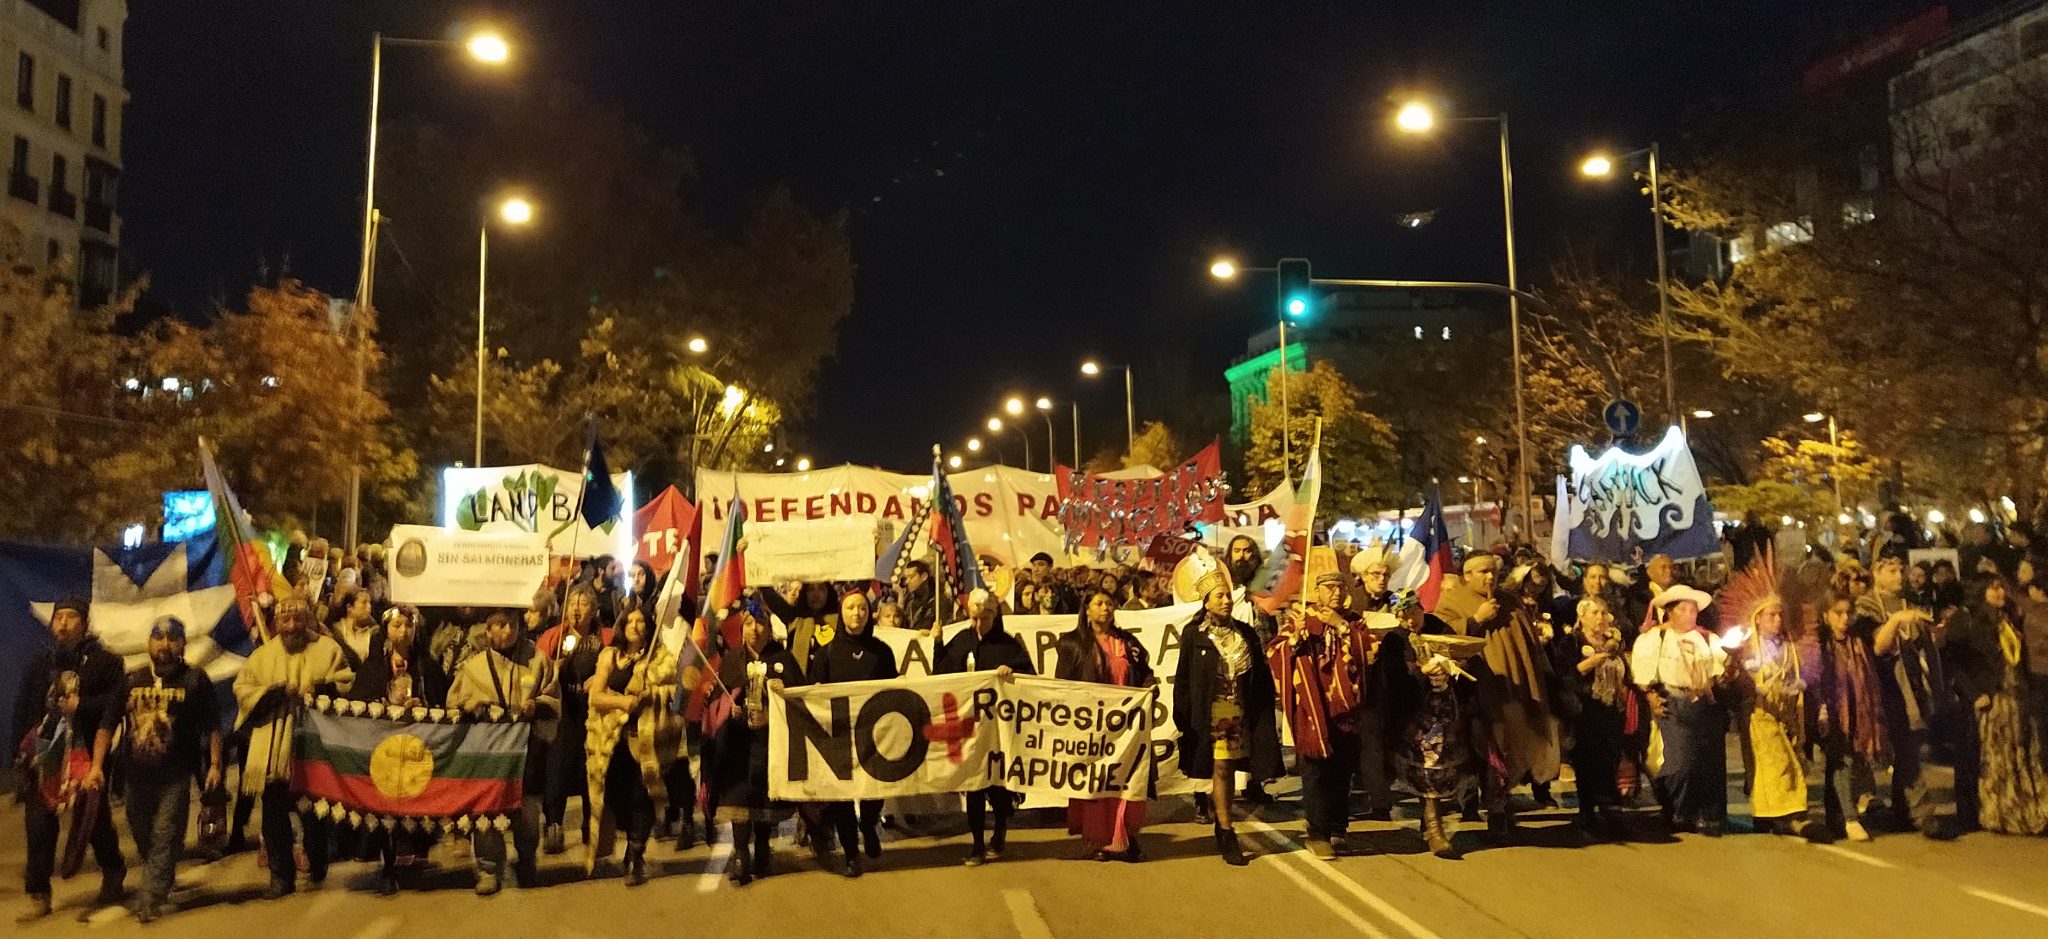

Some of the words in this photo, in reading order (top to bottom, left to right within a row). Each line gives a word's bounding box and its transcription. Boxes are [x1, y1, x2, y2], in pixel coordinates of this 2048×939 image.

[470, 487, 538, 523] LAND
[973, 687, 1147, 734] Represión
[1025, 729, 1043, 750] al
[1052, 733, 1116, 758] pueblo
[987, 743, 1147, 794] MAPUCHE!
